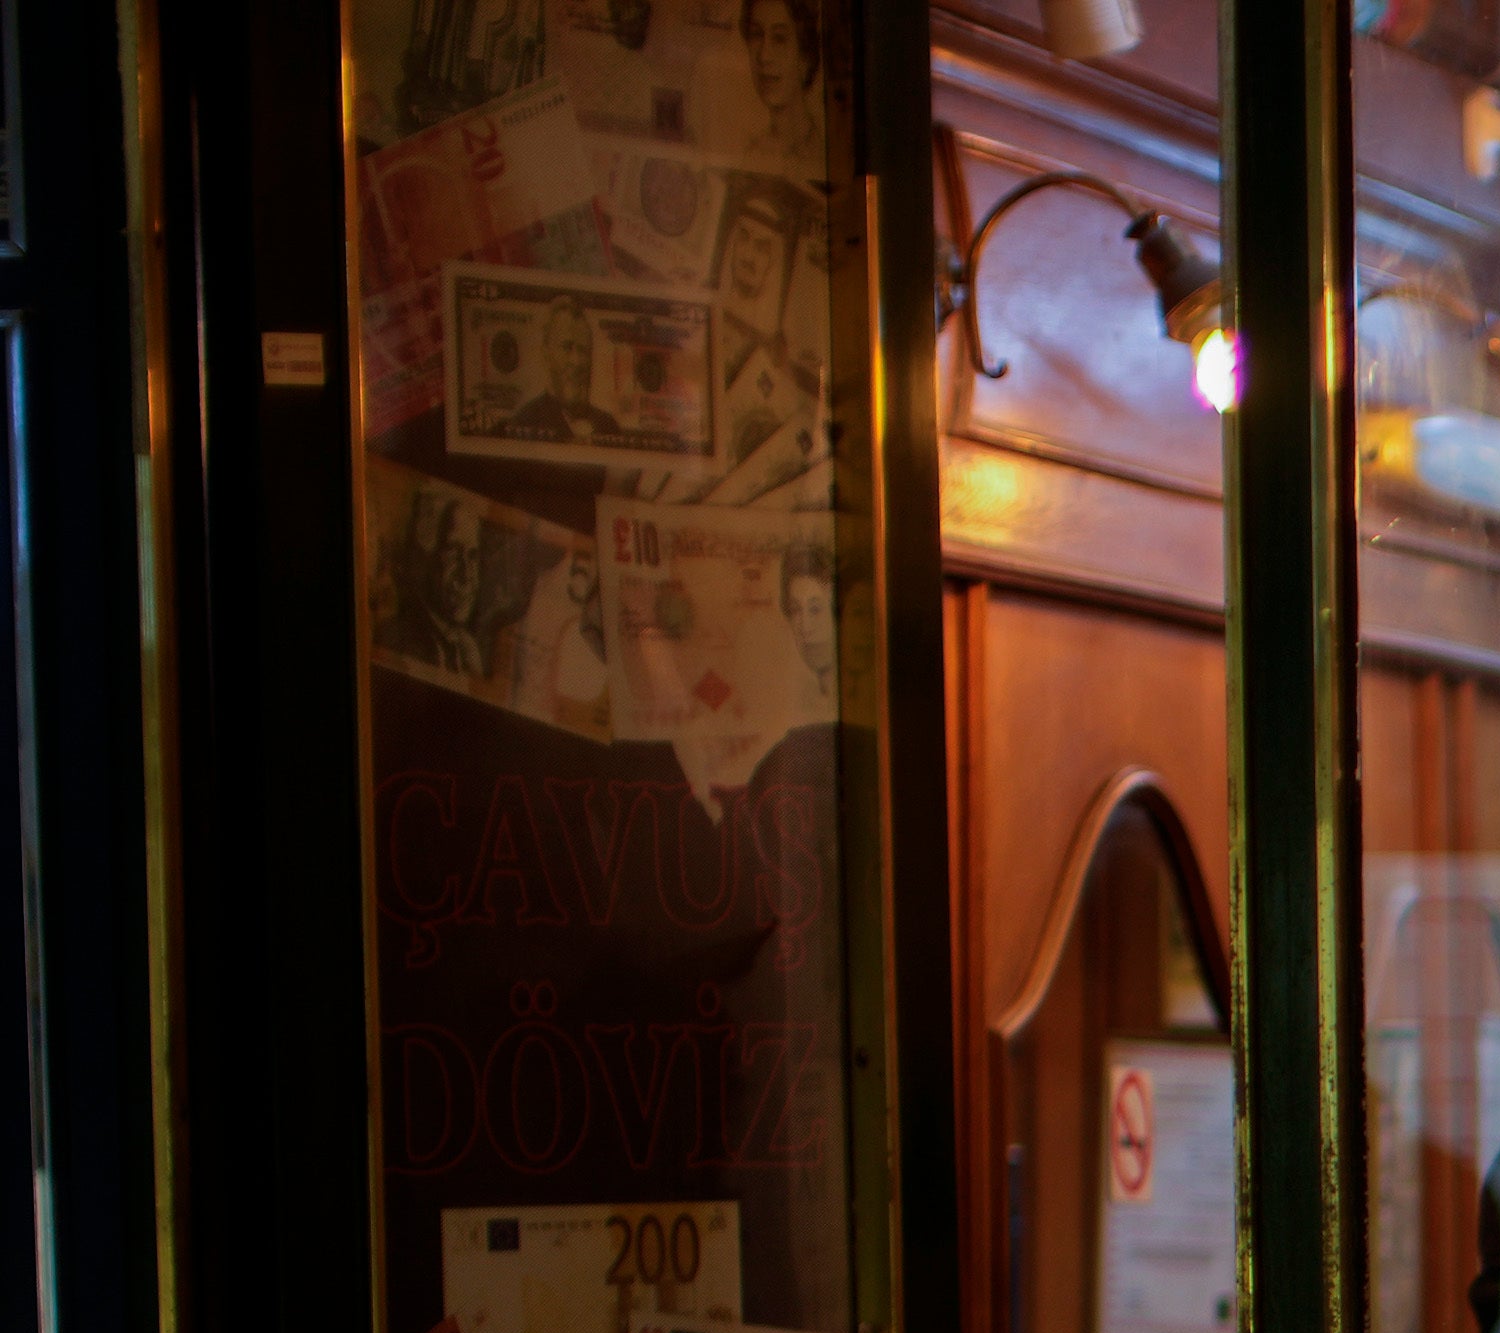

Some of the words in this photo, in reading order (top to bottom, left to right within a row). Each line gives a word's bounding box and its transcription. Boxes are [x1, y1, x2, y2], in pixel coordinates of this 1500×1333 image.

[375, 770, 821, 968] ÇAVUŞ
[385, 981, 824, 1175] DÖVİZ
[603, 1213, 701, 1287] 200
